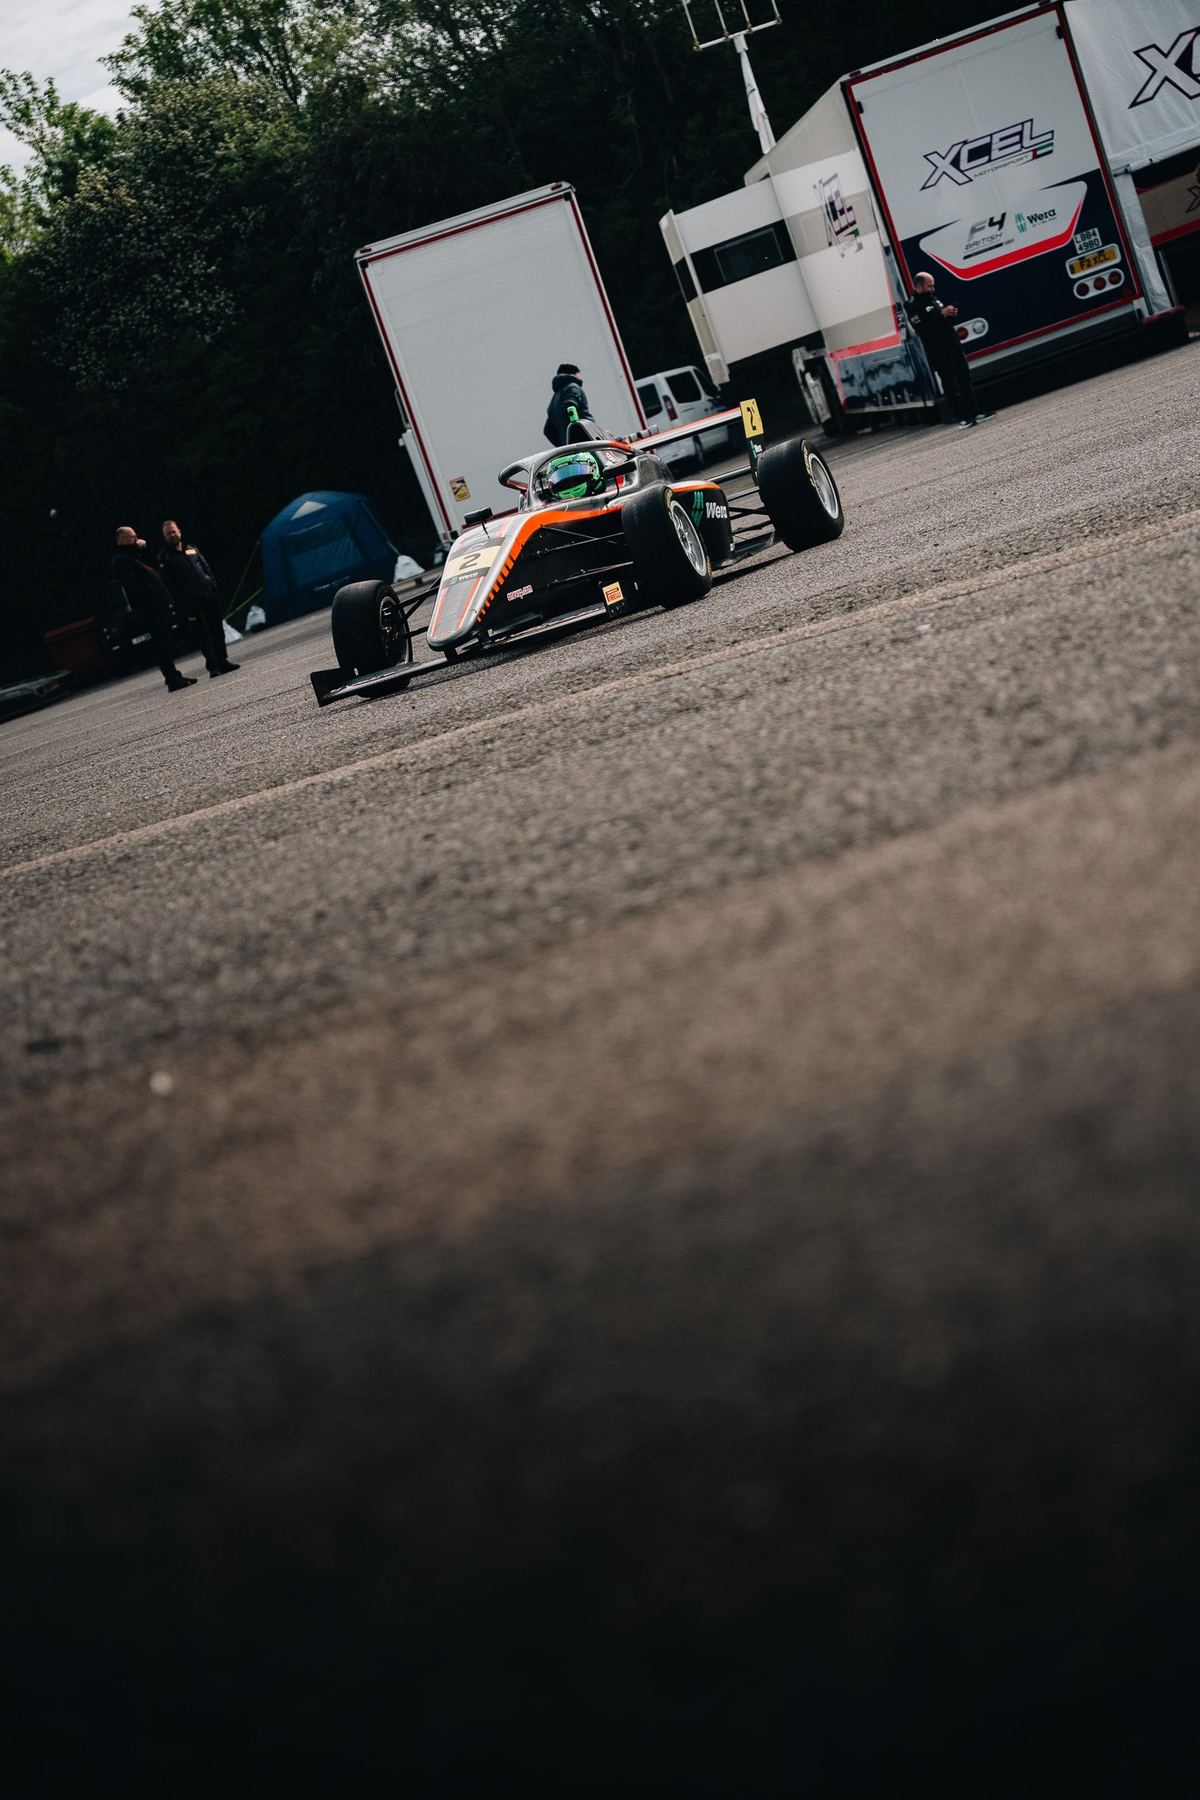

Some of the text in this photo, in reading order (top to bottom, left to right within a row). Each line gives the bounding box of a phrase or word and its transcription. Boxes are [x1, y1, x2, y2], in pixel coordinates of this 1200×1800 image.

[919, 117, 1054, 191] XCEL
[1026, 208, 1056, 224] Wera
[967, 212, 1006, 242] F4
[965, 231, 1003, 250] BRITISH
[459, 553, 481, 571] 2
